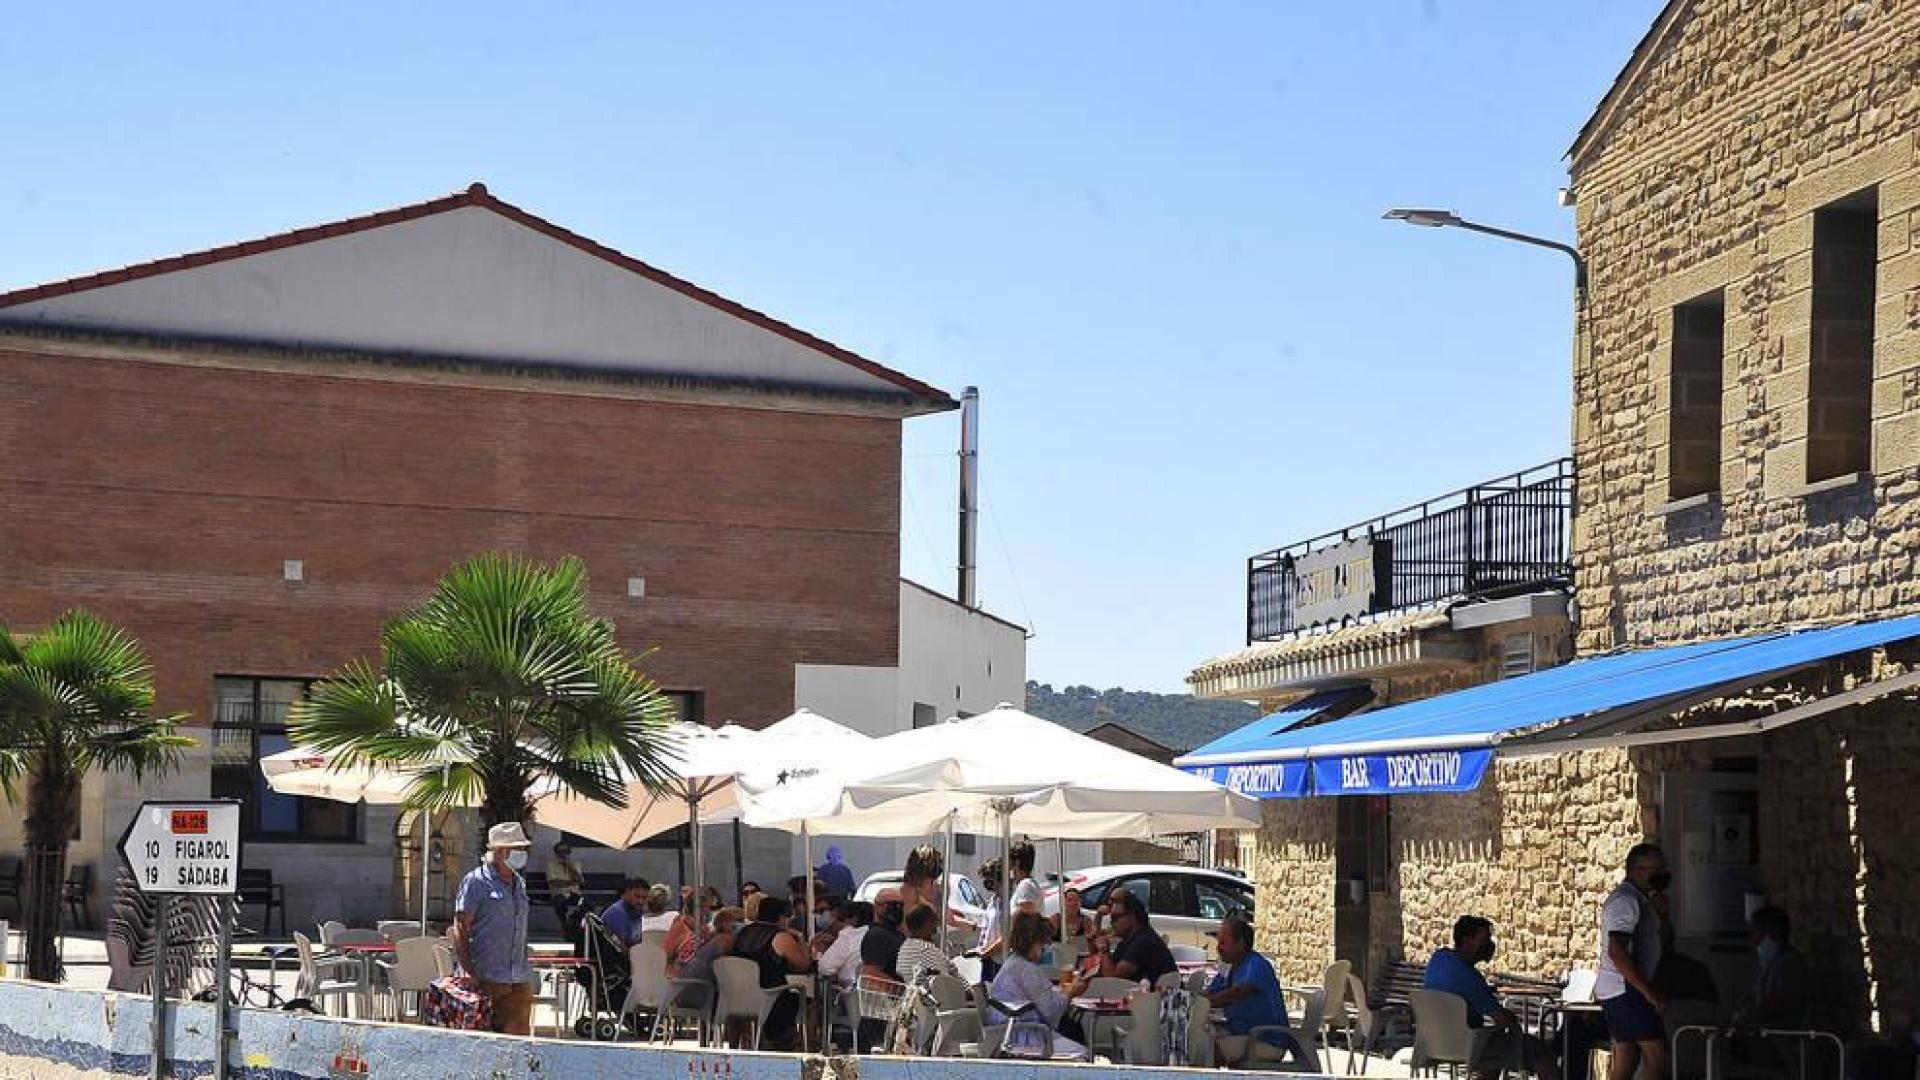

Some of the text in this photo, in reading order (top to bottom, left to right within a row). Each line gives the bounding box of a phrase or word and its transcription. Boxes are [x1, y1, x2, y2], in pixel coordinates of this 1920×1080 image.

[1227, 765, 1284, 792] DEPORTIVO
[1342, 752, 1461, 788] BAR DEPORTIVO
[145, 840, 230, 859] 10 FIGAROL
[145, 863, 229, 885] 19 SÁDABA
